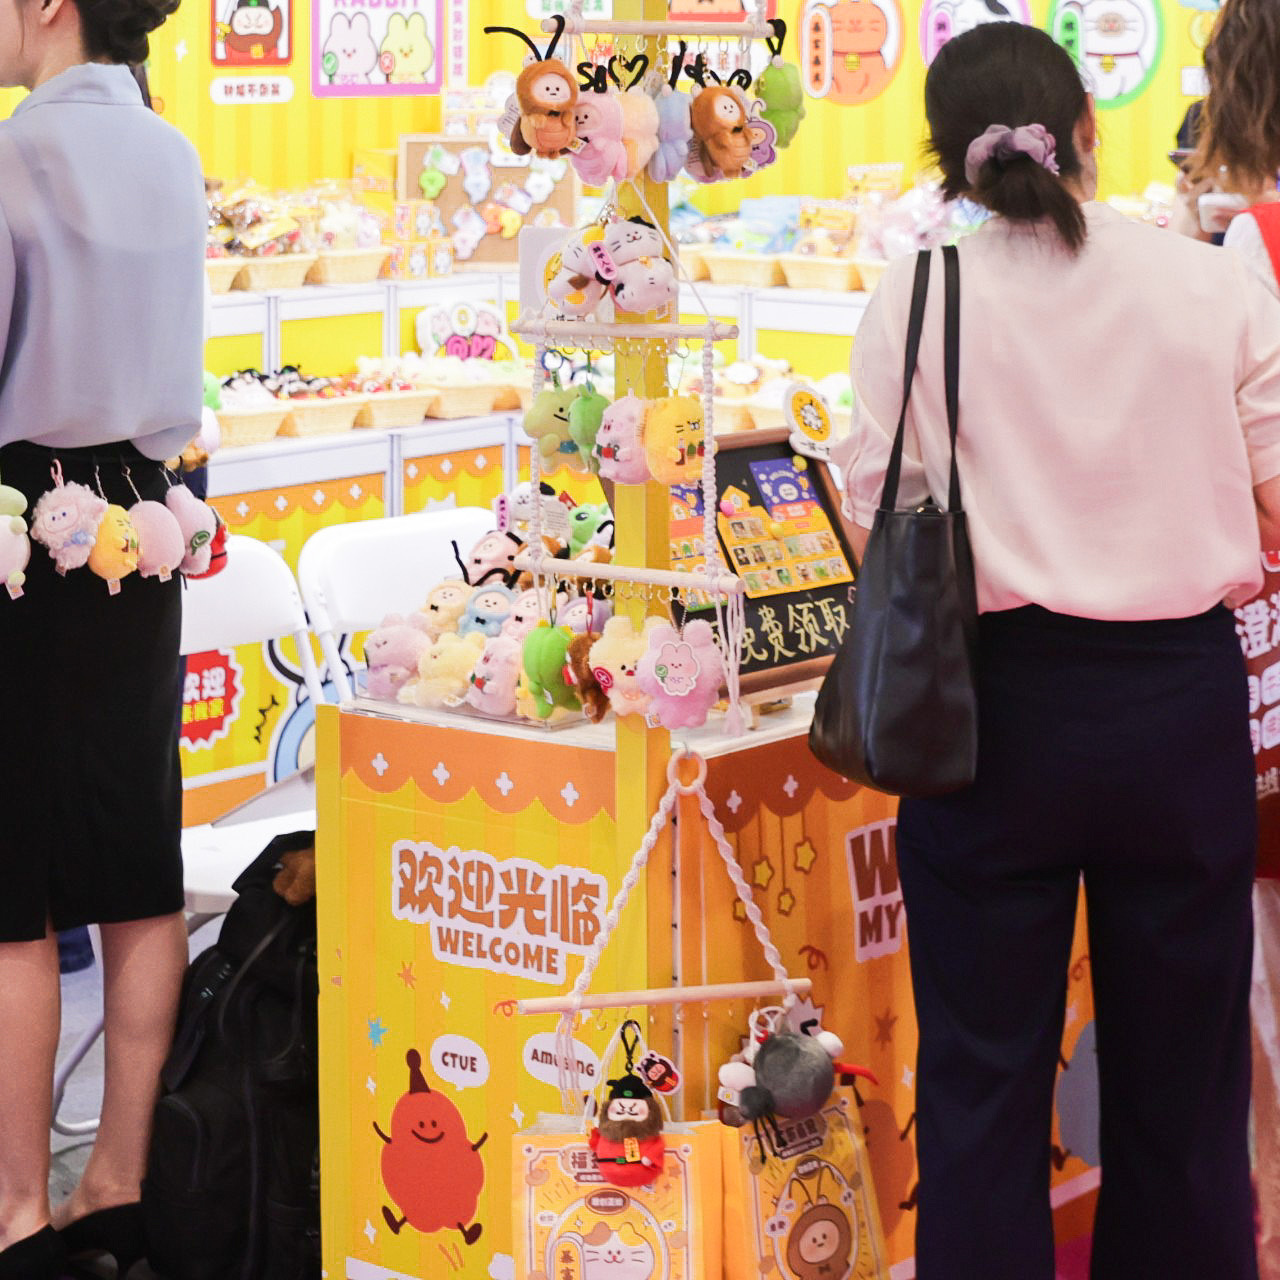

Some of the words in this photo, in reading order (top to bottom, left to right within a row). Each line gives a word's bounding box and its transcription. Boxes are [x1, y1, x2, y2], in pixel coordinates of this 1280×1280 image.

[397, 848, 601, 947] 欢迎光临
[859, 900, 904, 949] MY
[437, 926, 559, 976] WELCOME
[441, 1053, 478, 1074] CTUE
